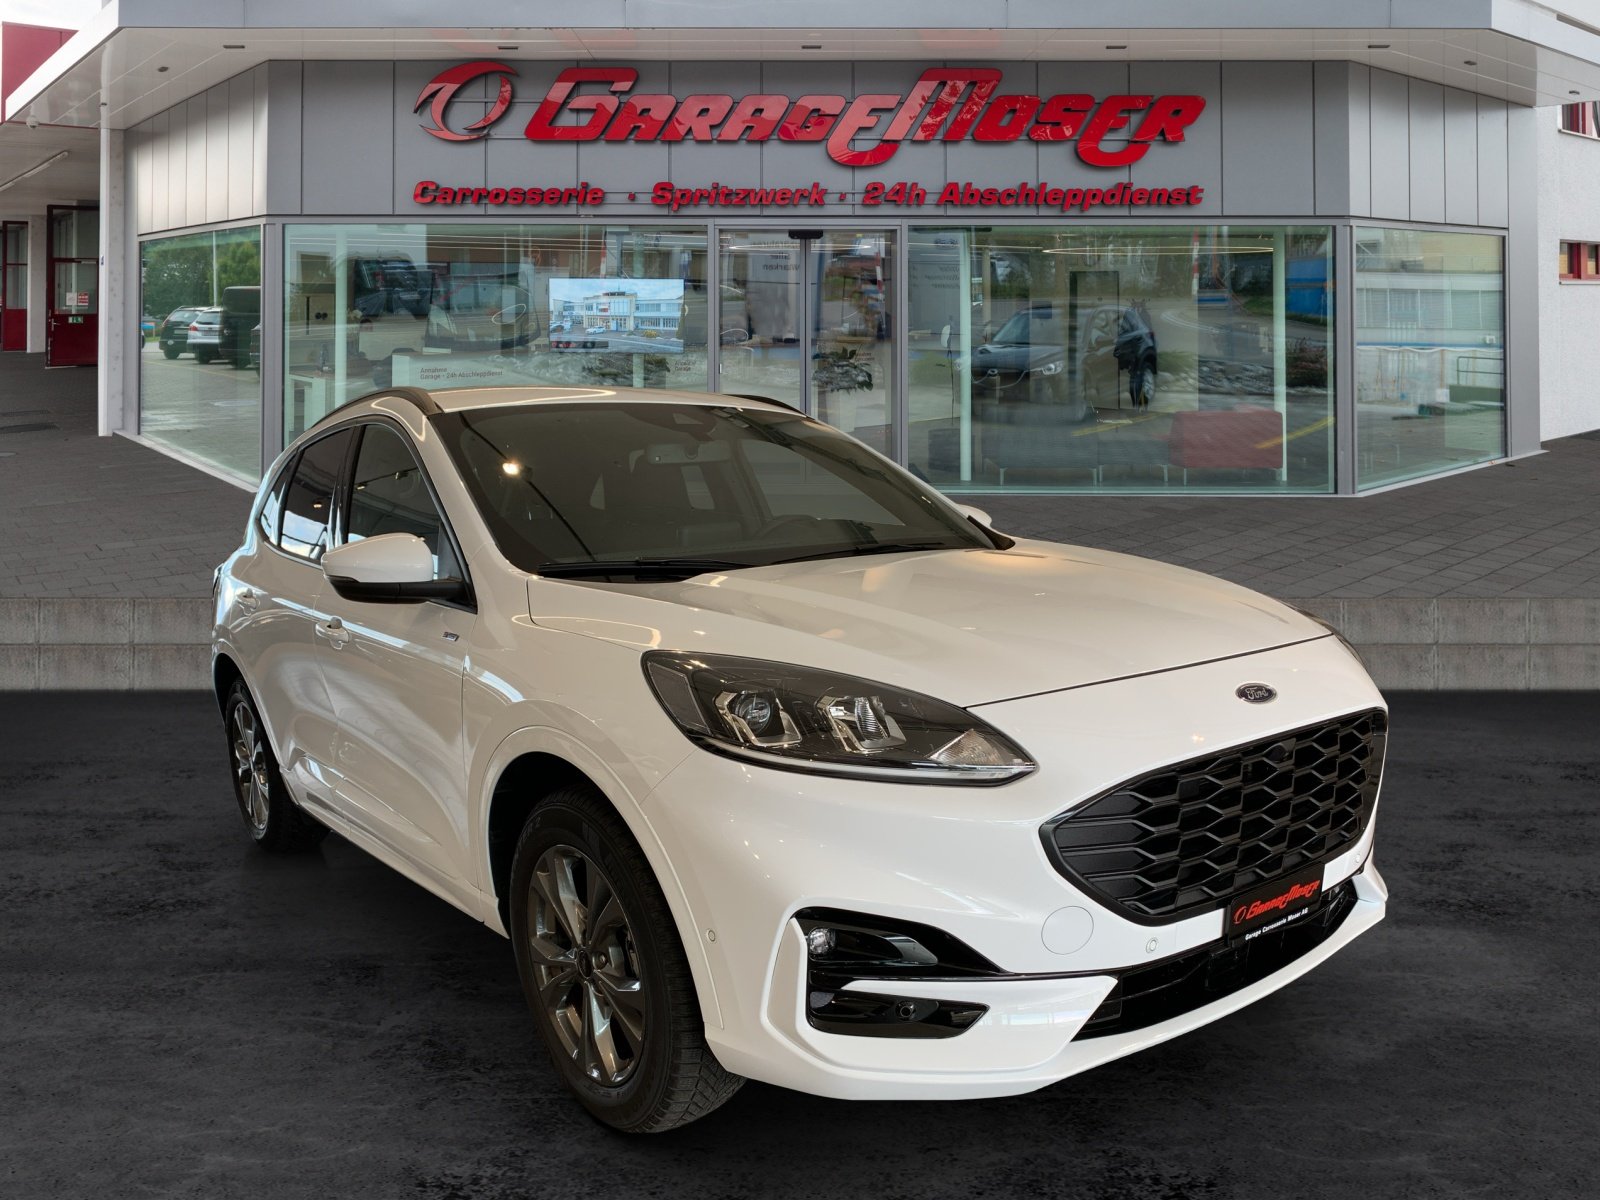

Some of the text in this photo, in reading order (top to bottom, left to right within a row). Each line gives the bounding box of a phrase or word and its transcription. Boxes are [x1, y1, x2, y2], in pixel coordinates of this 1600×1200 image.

[413, 181, 1204, 211] Carrosserie Spritzwerk 24h Abschleppdienst
[1244, 686, 1269, 700] Ford
[1245, 929, 1262, 941] Garage
[1287, 910, 1301, 922] Moser
[1300, 907, 1309, 916] AG
